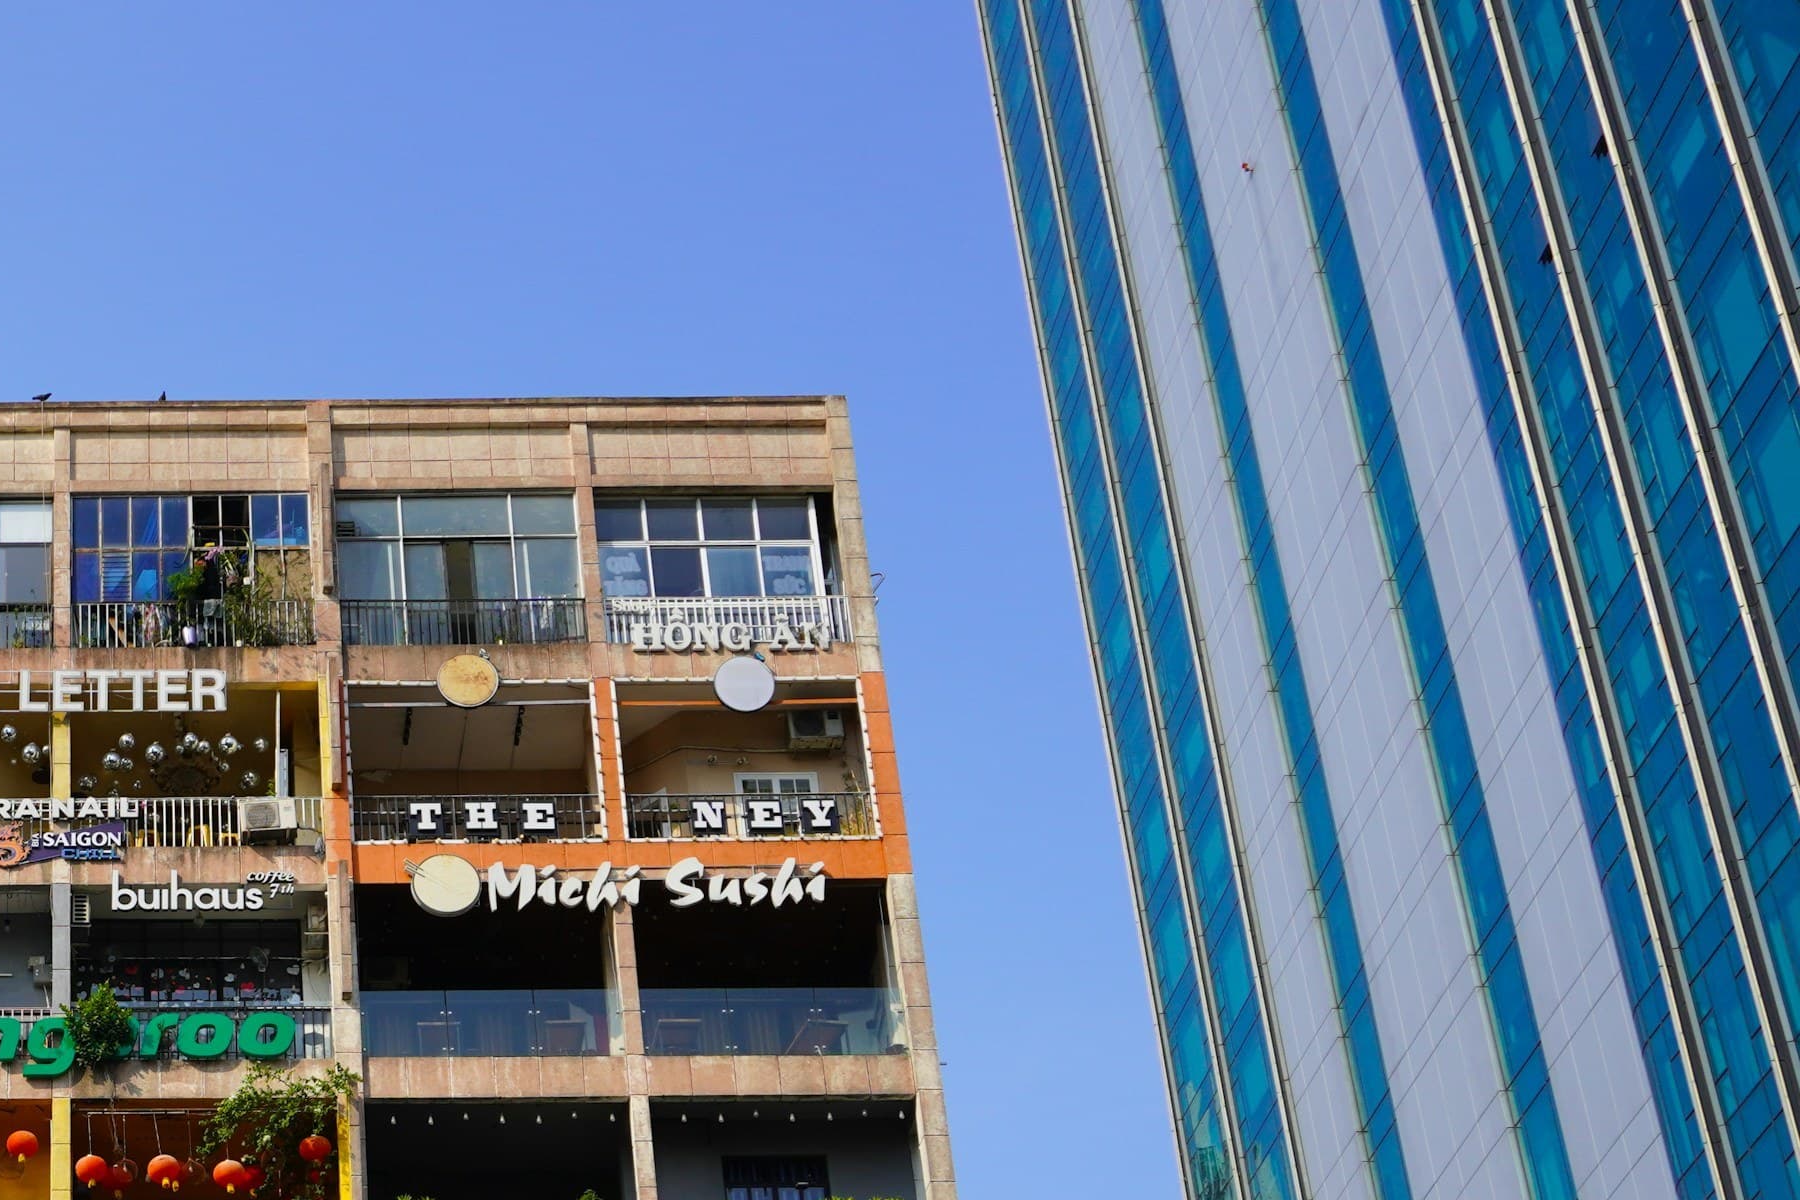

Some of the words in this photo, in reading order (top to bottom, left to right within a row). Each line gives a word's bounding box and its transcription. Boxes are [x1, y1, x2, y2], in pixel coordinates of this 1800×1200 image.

[19, 668, 227, 712] LETTER
[51, 797, 140, 818] NAIL
[409, 800, 557, 831] THE
[692, 799, 837, 830] NEY
[43, 831, 122, 847] SAIGON
[111, 869, 265, 912] buihaus
[246, 871, 296, 883] coffee
[269, 883, 295, 899] 7th
[488, 859, 641, 912] Michi
[665, 856, 827, 908] Sushi
